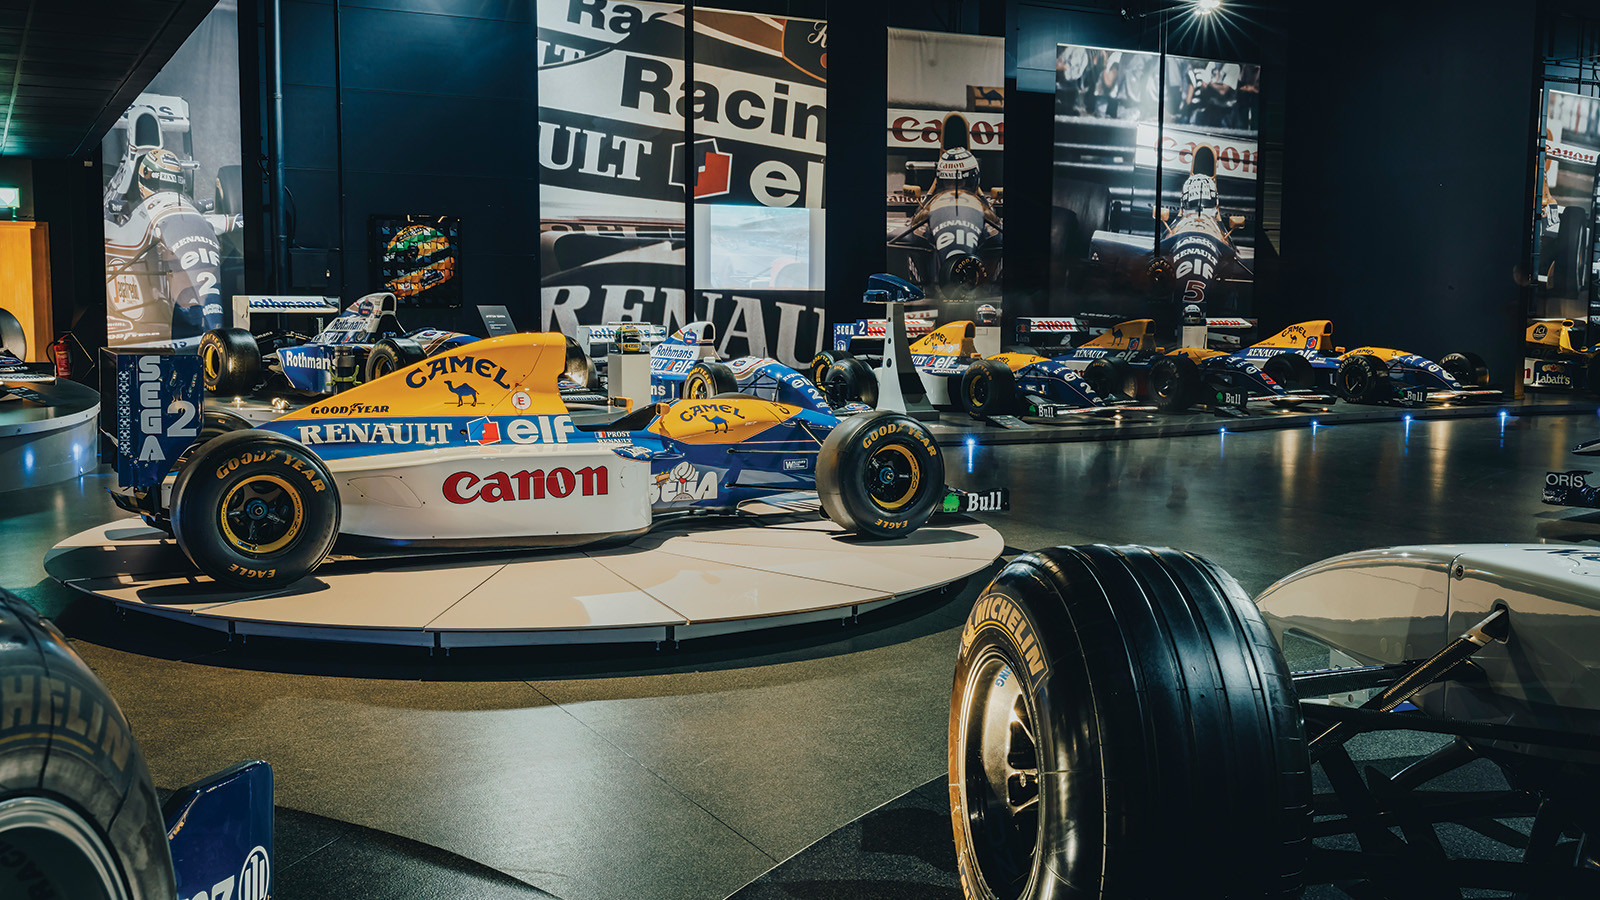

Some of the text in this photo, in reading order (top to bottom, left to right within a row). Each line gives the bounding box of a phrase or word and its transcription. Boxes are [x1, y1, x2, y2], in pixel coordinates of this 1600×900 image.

[892, 117, 1004, 145] Cao
[933, 220, 981, 236] RENAULT
[171, 235, 221, 253] RENAULT
[936, 229, 979, 251] elf
[180, 248, 220, 270] elf
[1173, 248, 1219, 266] RENAULT
[1176, 259, 1214, 280] elf
[197, 271, 220, 297] 2
[1182, 280, 1206, 303] 5
[249, 299, 327, 310] othmans
[836, 325, 854, 335] SEGA
[858, 321, 866, 335] 2
[1031, 319, 1073, 331] Canon
[1281, 325, 1307, 338] CAMEL
[924, 332, 947, 345] CAMEL
[655, 345, 694, 359] Rothmans
[1115, 351, 1139, 361] elf
[1247, 348, 1286, 357] RENAULT
[673, 360, 695, 373] elf
[934, 356, 958, 369] elf
[405, 355, 511, 389] CAMEL
[1536, 373, 1571, 386] Labatt's
[517, 396, 525, 406] E
[1225, 392, 1241, 405] Bull
[1407, 391, 1424, 402] Bull
[138, 355, 166, 461] SEGA
[679, 404, 745, 422] CAMEL
[1038, 405, 1054, 417] Bull
[167, 400, 197, 437] 2
[297, 422, 452, 445] RENAULT
[506, 415, 574, 444] elf
[606, 431, 631, 442] PROST
[442, 466, 608, 504] Canon
[1546, 473, 1583, 489] ORIS
[967, 491, 1002, 512] Bull
[875, 518, 908, 529] EAGLE
[228, 563, 276, 579] EAGLE
[974, 597, 1044, 677] MICHELIN
